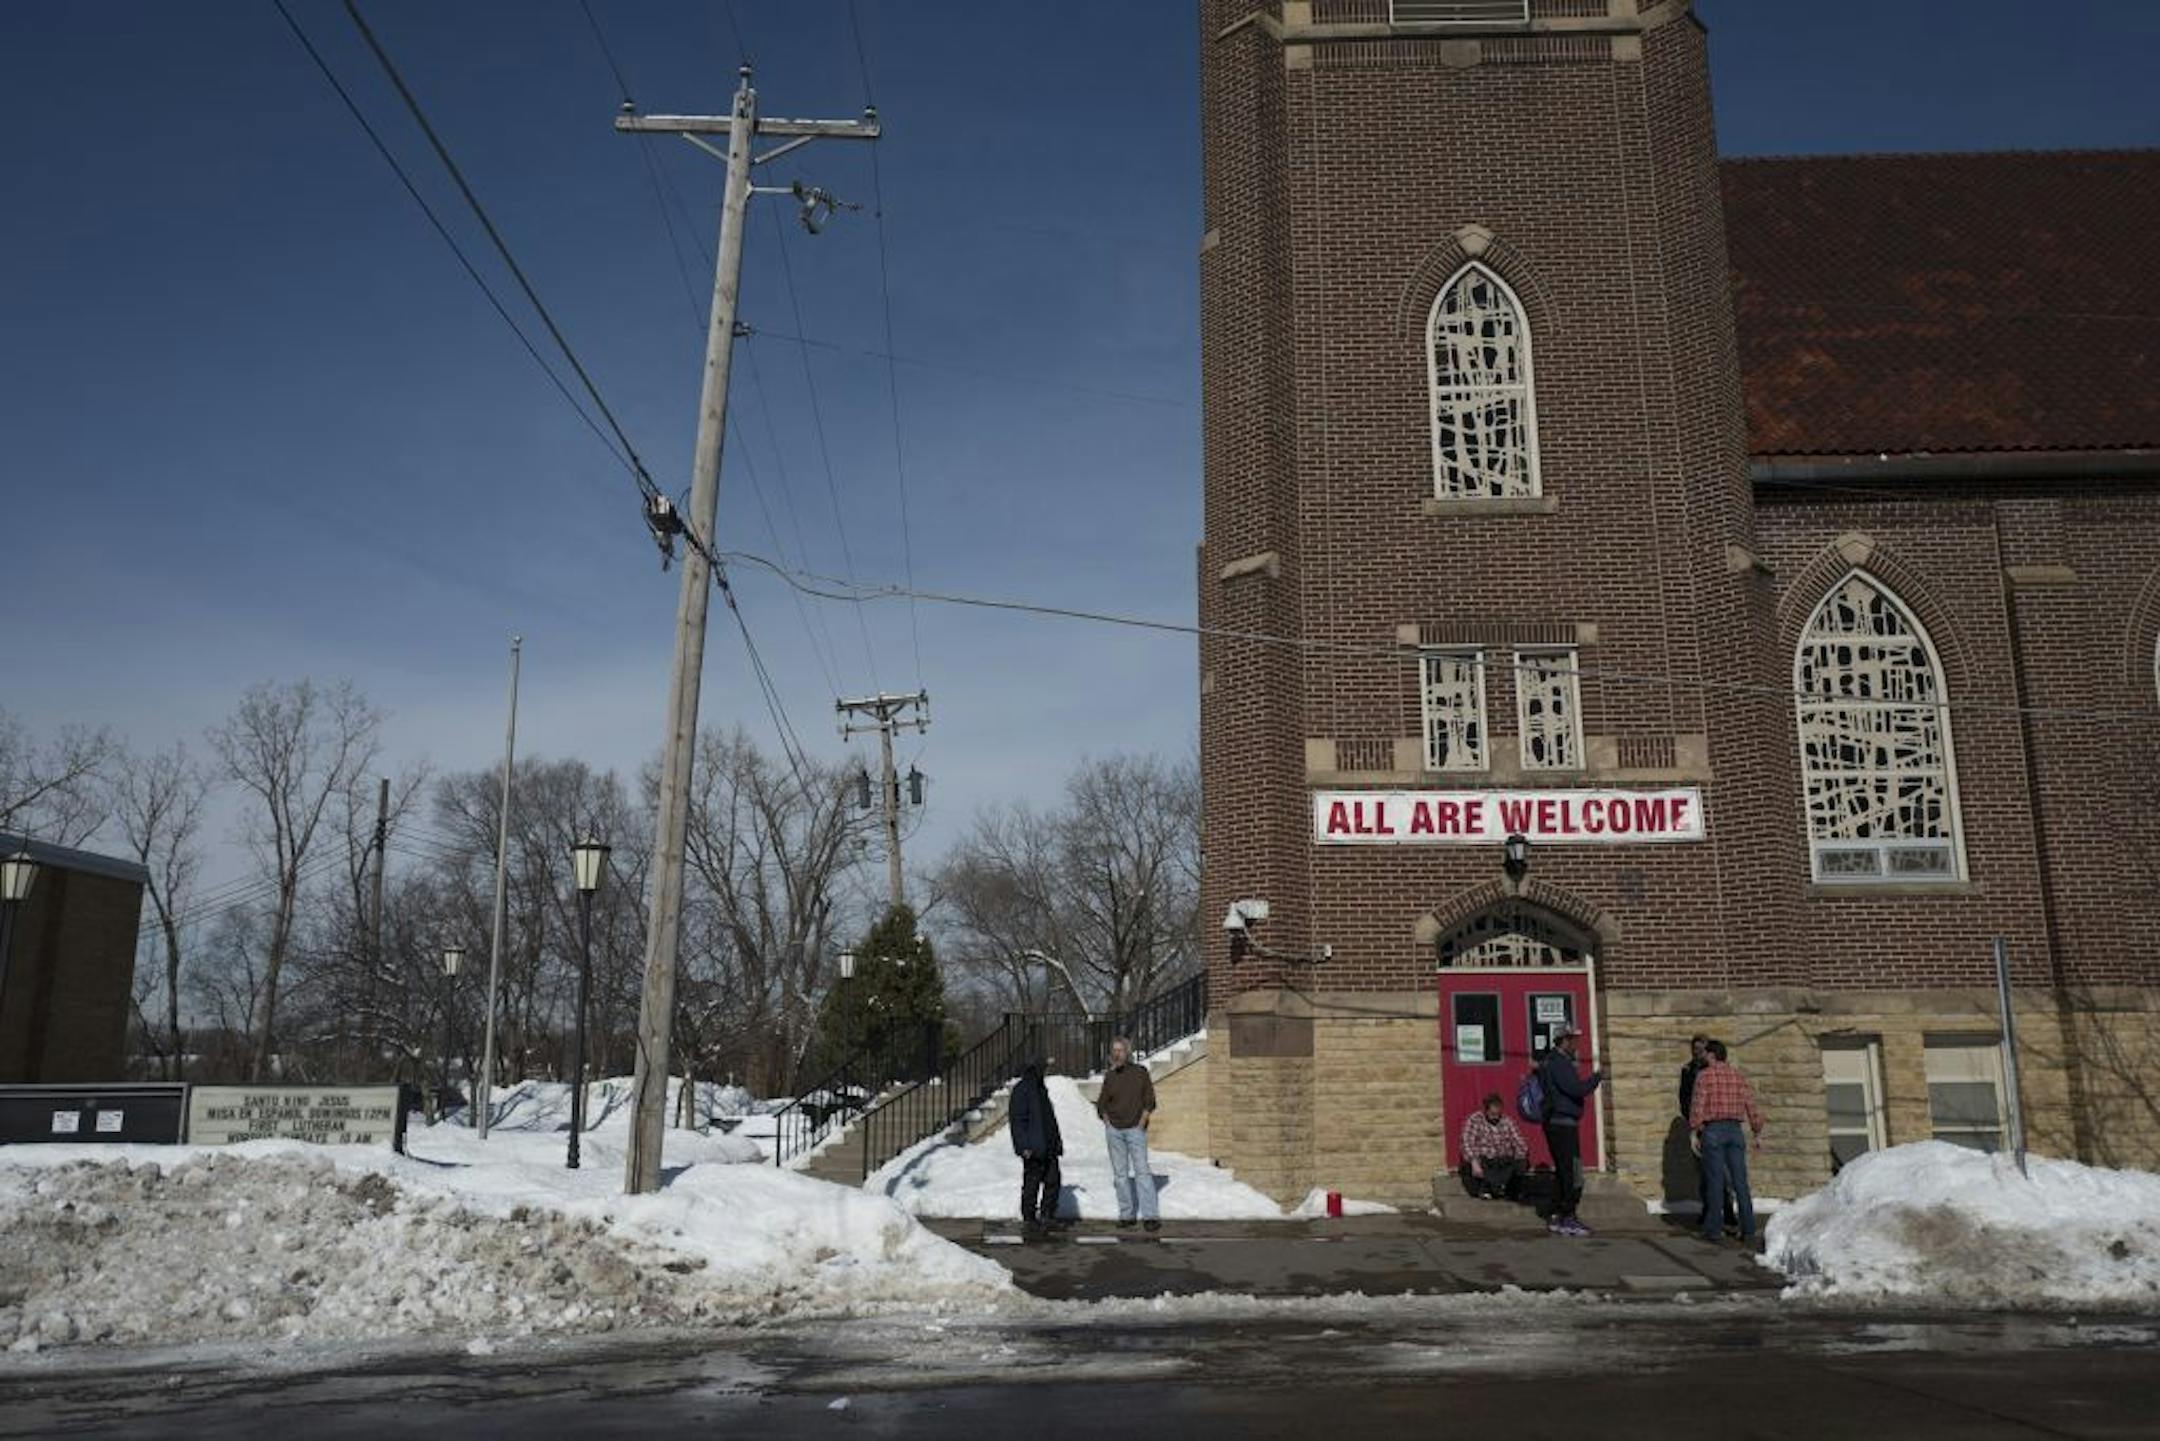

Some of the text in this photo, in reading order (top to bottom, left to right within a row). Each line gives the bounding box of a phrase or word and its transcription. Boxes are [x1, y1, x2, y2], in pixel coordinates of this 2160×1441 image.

[1327, 798, 1690, 834] ALL ARE WELCOME
[207, 1108, 235, 1119] MISA
[239, 1108, 252, 1119] EN
[249, 1120, 345, 1132] FIRST LUTHERAN
[355, 1132, 372, 1144] AM
